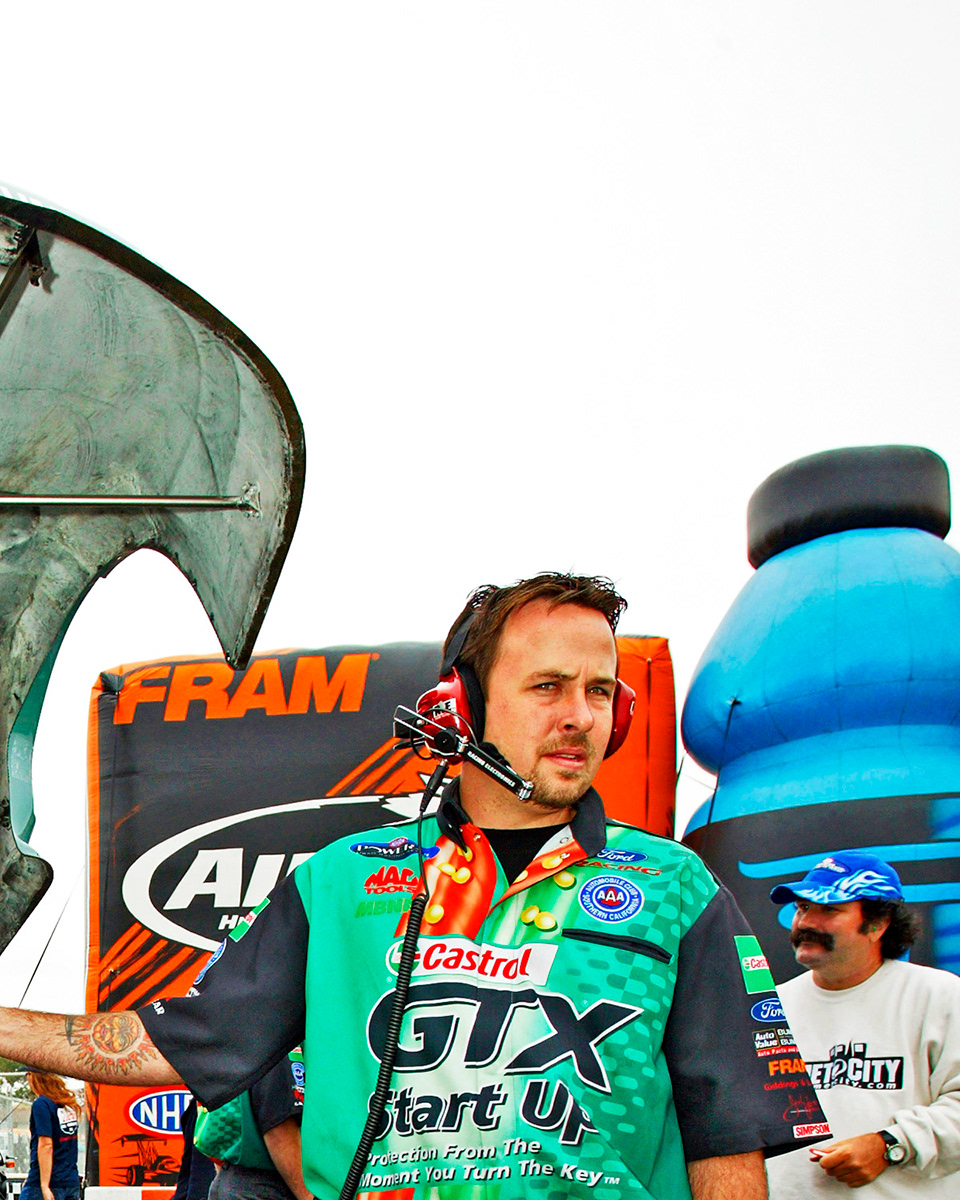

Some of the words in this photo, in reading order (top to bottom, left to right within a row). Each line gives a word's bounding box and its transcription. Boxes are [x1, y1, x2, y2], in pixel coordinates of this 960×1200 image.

[113, 653, 372, 725] FRAM
[597, 848, 636, 862] Ford
[364, 865, 418, 887] MAC
[585, 877, 625, 893] AUTOMOBILE
[582, 894, 608, 919] SOUTHERN
[608, 898, 640, 920] CALIFORNIA
[597, 889, 625, 902] AAA
[423, 943, 532, 979] Castrol
[366, 980, 644, 1096] GTX
[754, 1039, 778, 1049] Value
[756, 1031, 775, 1041] Auto
[847, 1058, 901, 1083] CITY
[367, 1083, 509, 1141] Start
[518, 1079, 600, 1146] Up
[795, 1123, 831, 1136] SIMPSON
[443, 1144, 497, 1160] From
[502, 1137, 542, 1155] The
[358, 1169, 421, 1189] Moment
[424, 1166, 456, 1182] You
[462, 1164, 511, 1181] Turn
[517, 1160, 555, 1177] The
